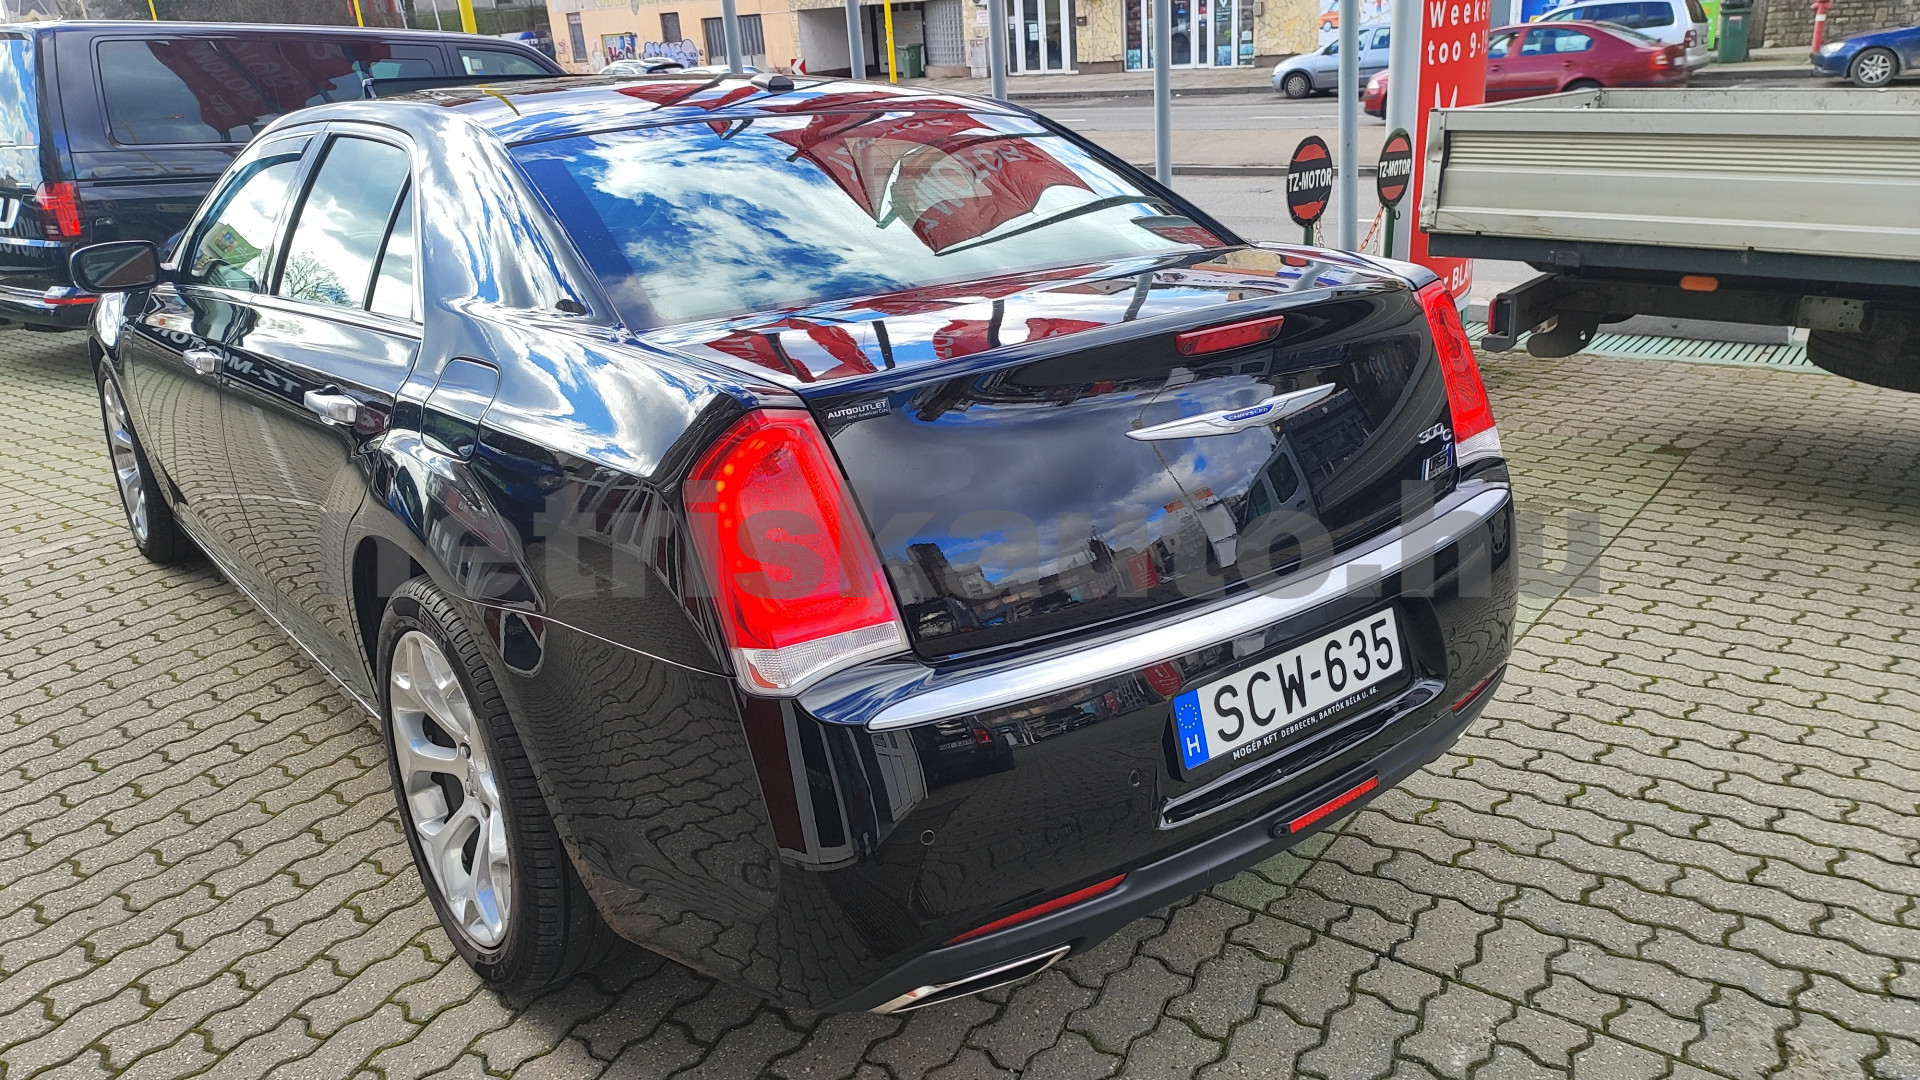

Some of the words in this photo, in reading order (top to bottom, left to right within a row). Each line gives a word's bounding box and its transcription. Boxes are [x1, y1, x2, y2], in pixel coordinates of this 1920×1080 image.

[1428, 40, 1461, 65] too
[1288, 168, 1332, 192] TZ-MOTOR
[1379, 159, 1411, 178] TZ-MOTOR
[1228, 407, 1269, 420] CHRYSLER
[1213, 618, 1394, 742] SCW-635
[1232, 740, 1262, 761] MOGÉP
[1263, 731, 1279, 746] KFT
[1281, 714, 1319, 738] DEBRECEN,
[1319, 701, 1345, 723] BARTÓK
[1186, 733, 1201, 757] H
